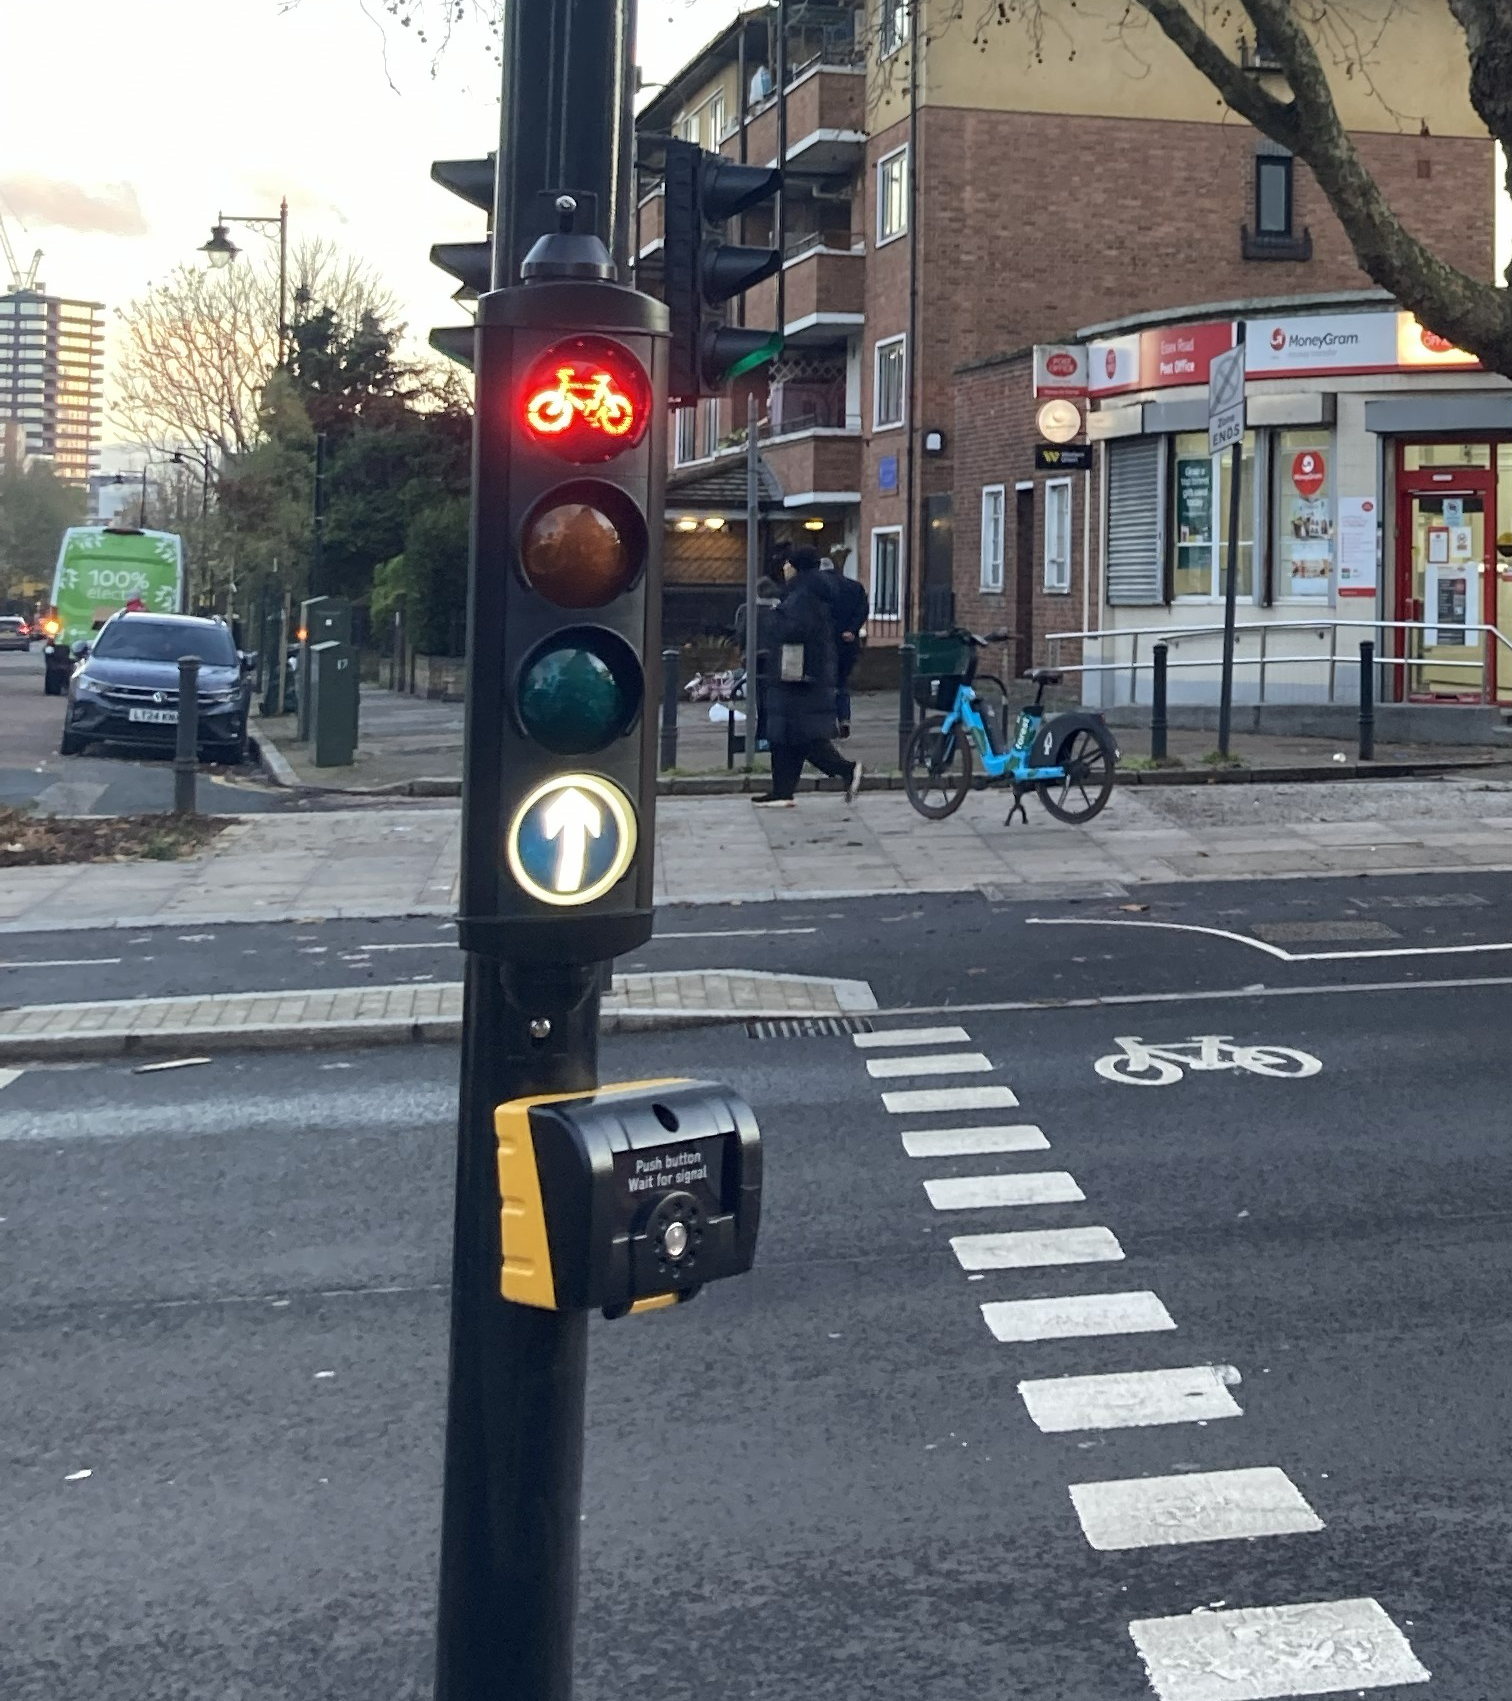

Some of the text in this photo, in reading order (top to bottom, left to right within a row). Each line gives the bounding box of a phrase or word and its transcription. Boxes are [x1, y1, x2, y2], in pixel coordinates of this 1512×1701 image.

[1288, 332, 1359, 349] MoneyGram
[1160, 359, 1195, 375] Post Office
[1212, 424, 1240, 446] ENDS
[88, 569, 150, 589] 100%
[635, 1152, 702, 1174] Push button
[628, 1165, 708, 1192] Wait for signal
